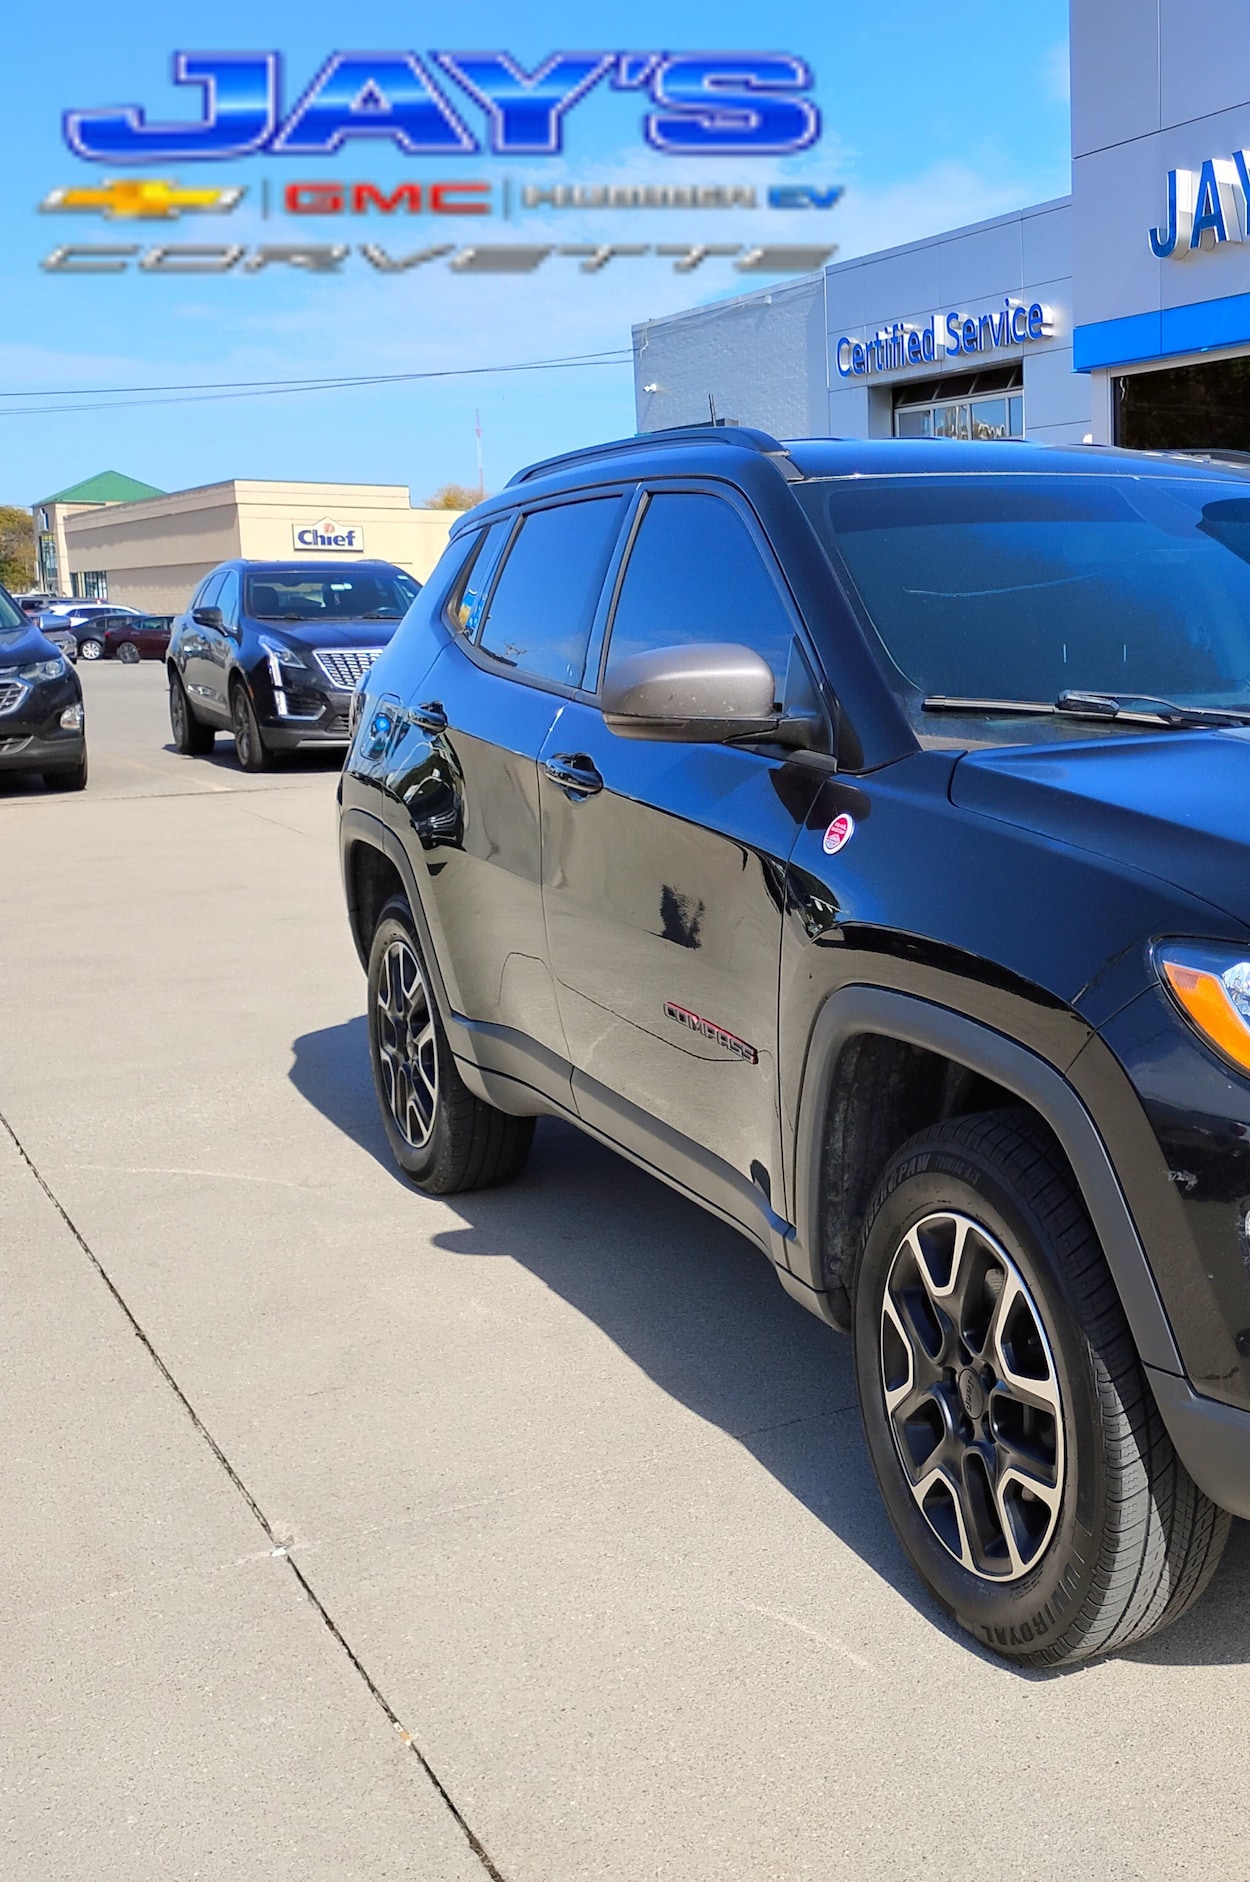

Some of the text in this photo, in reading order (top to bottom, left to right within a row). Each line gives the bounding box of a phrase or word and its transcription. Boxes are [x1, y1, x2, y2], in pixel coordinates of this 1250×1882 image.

[835, 297, 1050, 378] Certified Service
[297, 529, 356, 547] Chief
[663, 1001, 759, 1065] COMPASS
[980, 1563, 1081, 1646] UNIROYAL
